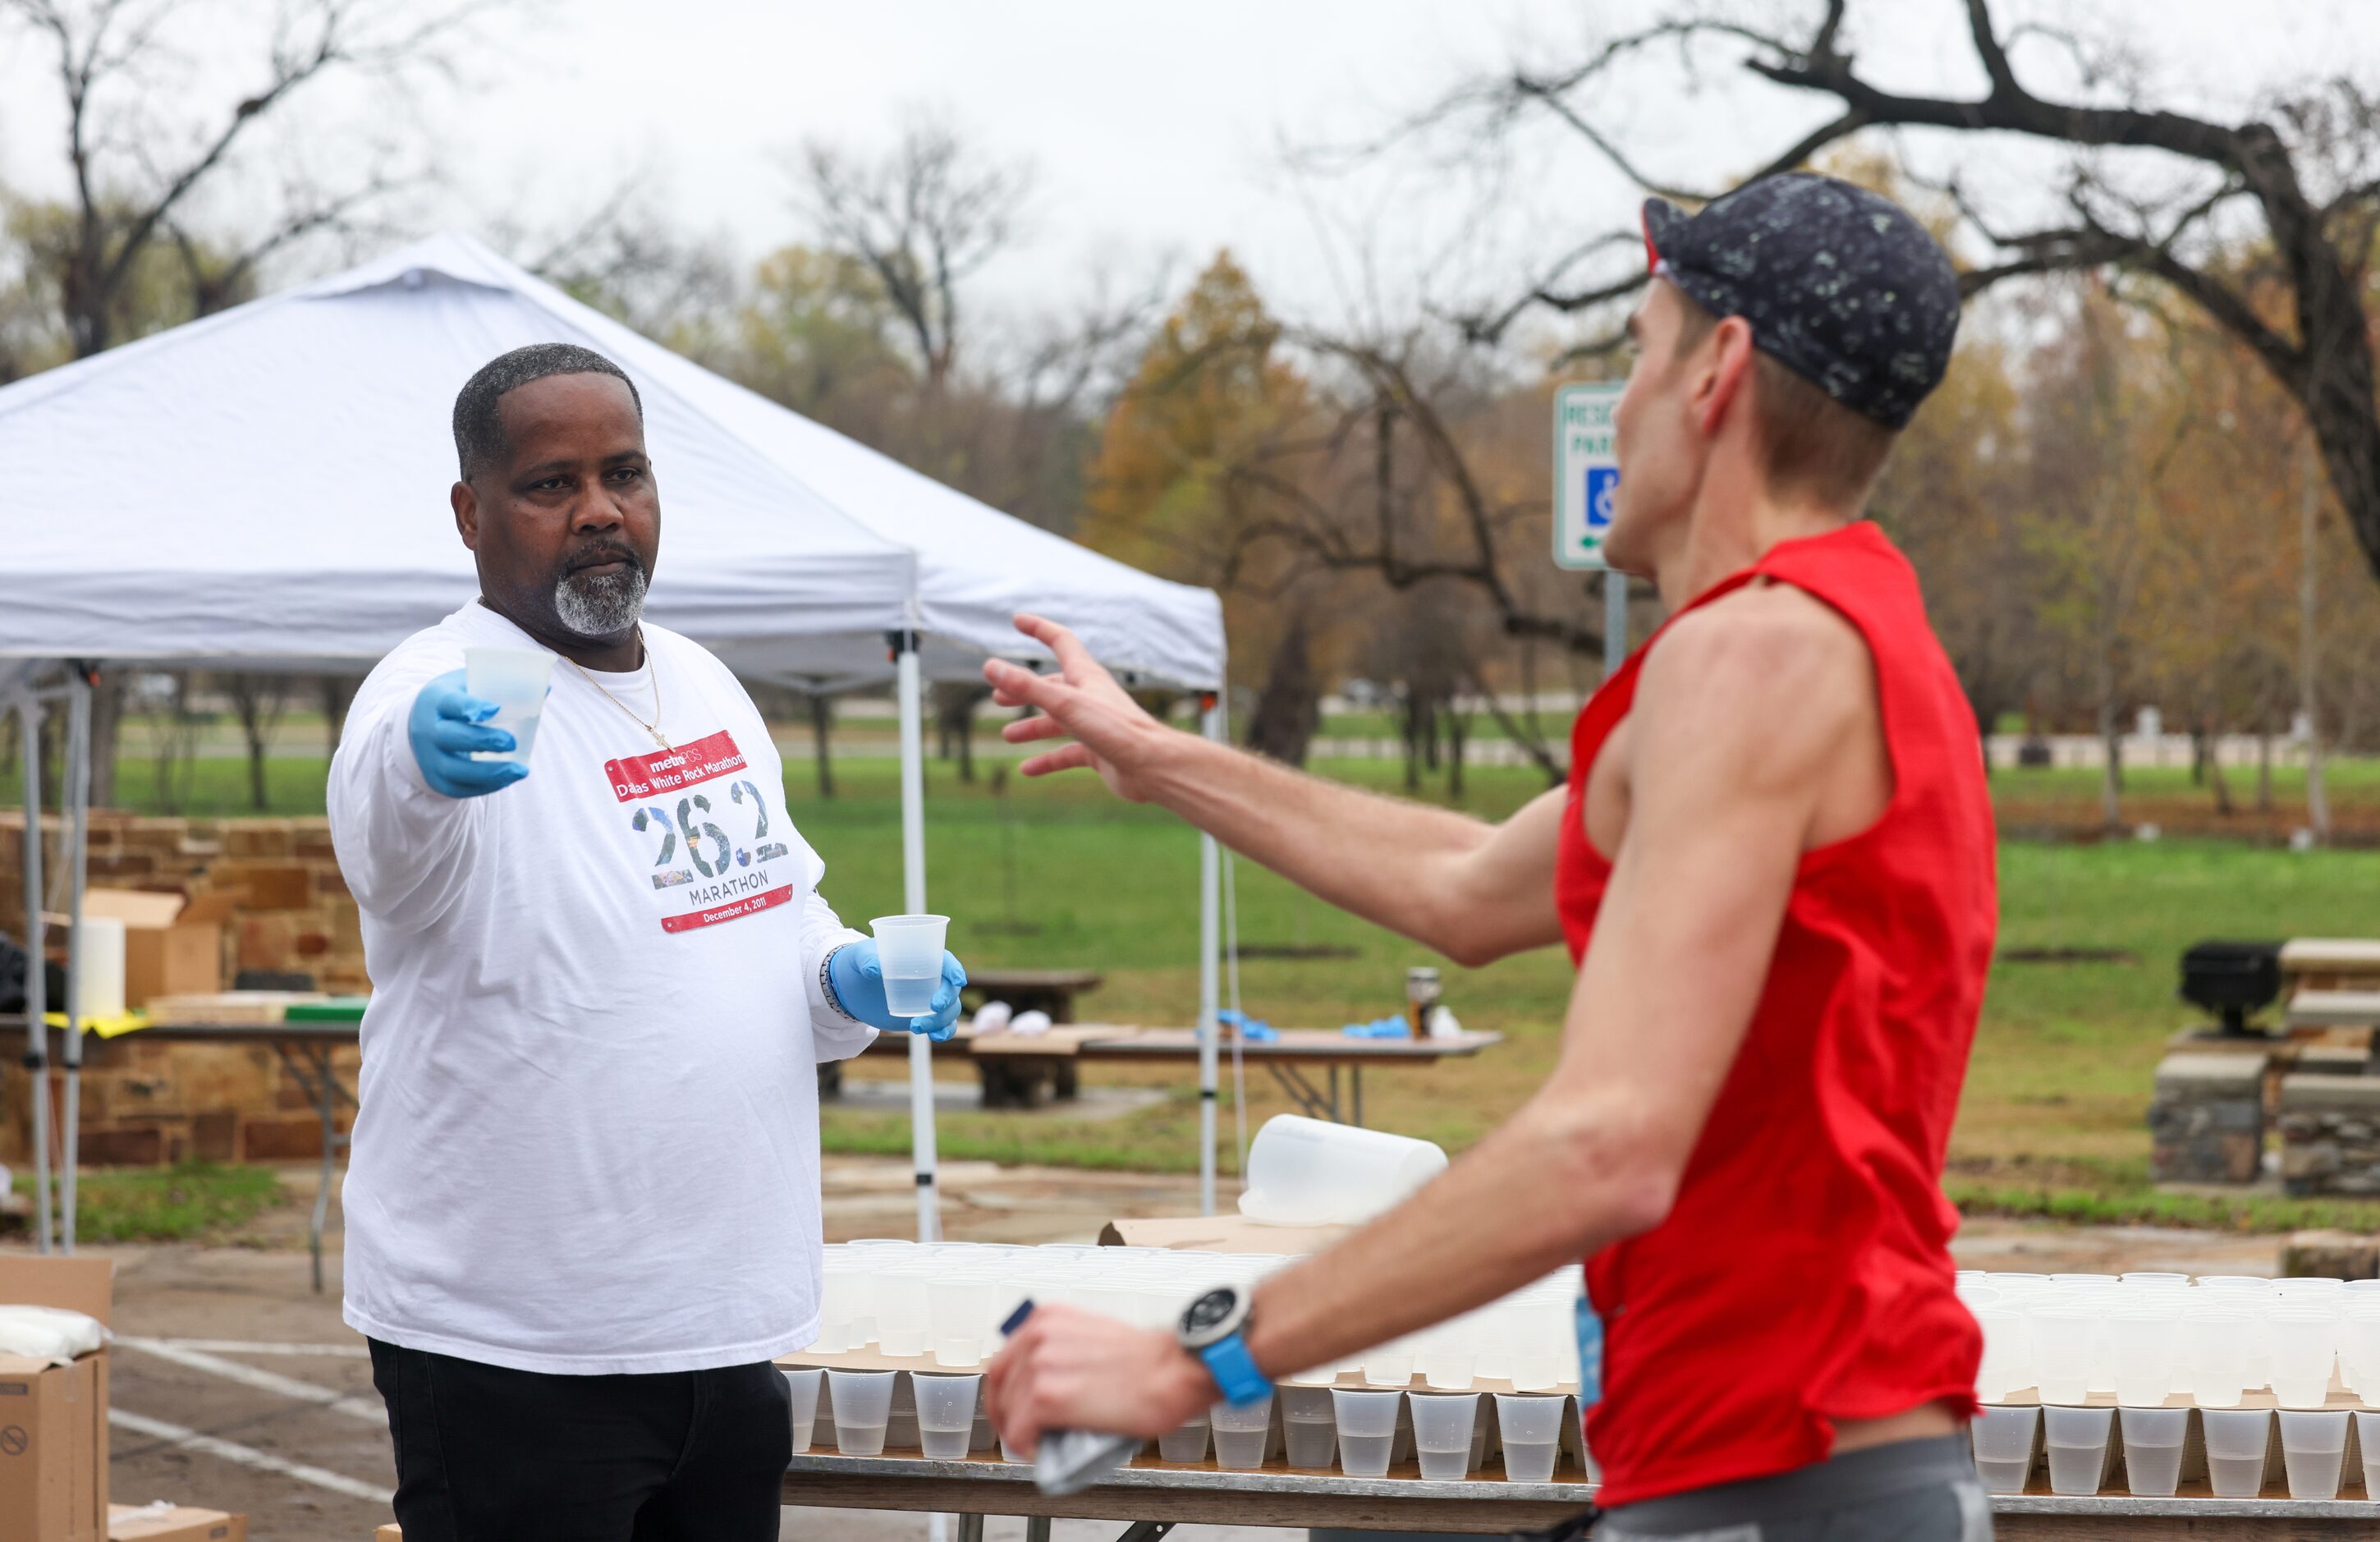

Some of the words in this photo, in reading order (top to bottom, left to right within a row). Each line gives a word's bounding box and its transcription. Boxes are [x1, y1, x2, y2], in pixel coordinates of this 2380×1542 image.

[649, 748, 703, 773] metroPCS
[649, 773, 681, 790] White
[682, 764, 706, 782] Rock
[704, 753, 745, 773] Marathon
[632, 780, 789, 890] 26.2
[689, 870, 768, 906] MARATHON
[703, 906, 743, 923] December
[744, 903, 753, 913] 4,
[751, 897, 767, 910] 2011
